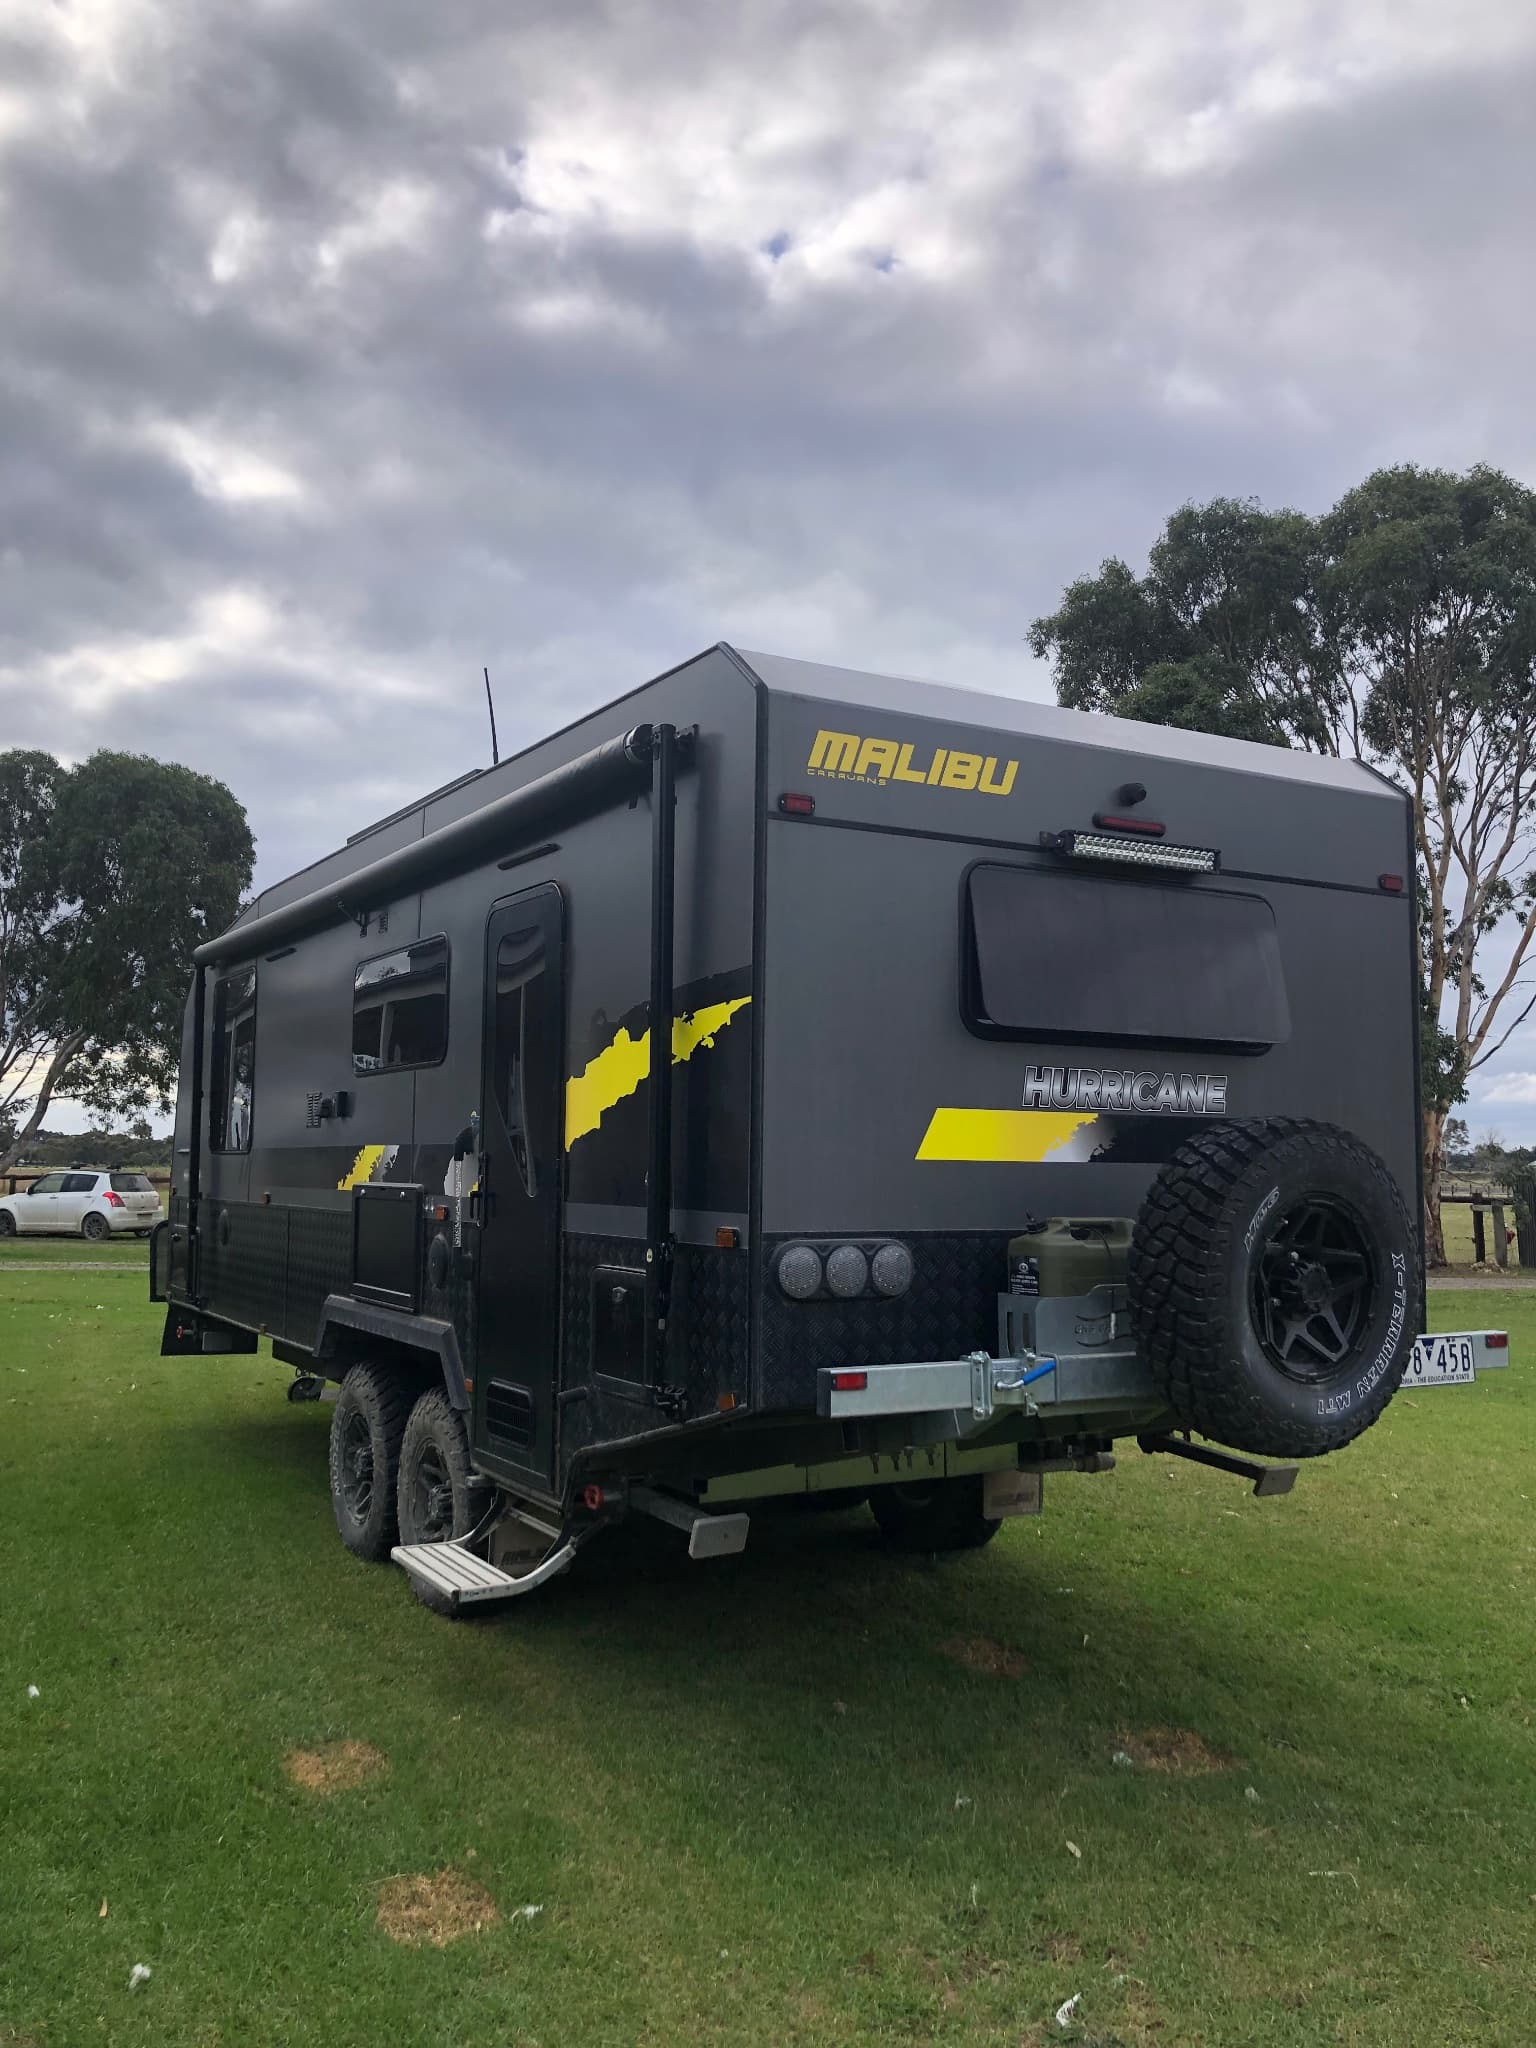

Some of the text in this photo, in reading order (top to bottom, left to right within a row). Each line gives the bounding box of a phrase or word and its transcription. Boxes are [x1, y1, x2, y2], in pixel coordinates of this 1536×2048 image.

[807, 729, 1020, 797] MALIBU
[807, 768, 888, 787] CARAVANS
[1021, 1065, 1228, 1114] HURRICANE
[1427, 1374, 1455, 1383] EDUCATION
